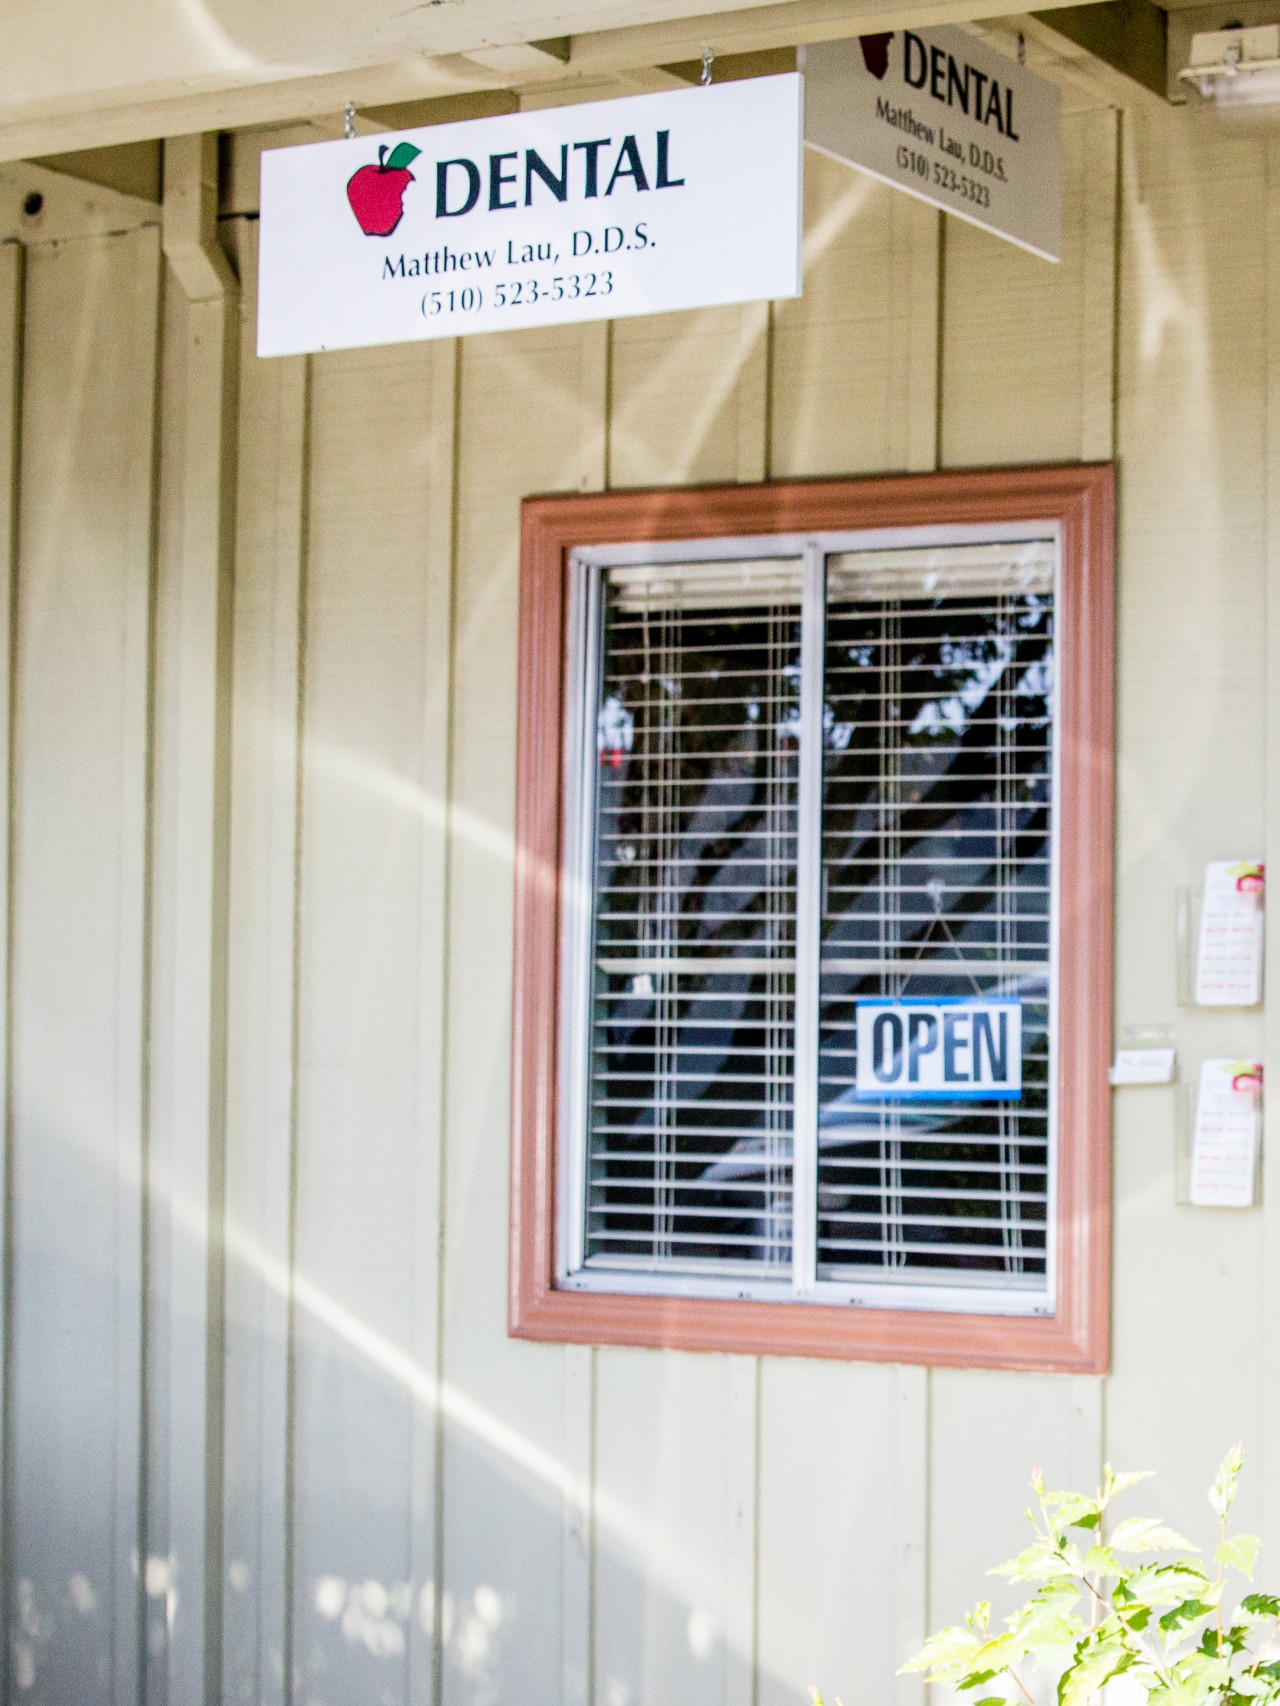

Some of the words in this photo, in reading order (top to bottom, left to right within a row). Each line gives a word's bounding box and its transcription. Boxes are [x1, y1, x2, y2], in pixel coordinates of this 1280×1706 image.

[904, 29, 1019, 142] DENTAL
[435, 129, 686, 219] DENTAL
[875, 95, 935, 146] Matthew
[939, 127, 966, 164] Lau,
[969, 142, 1009, 183] D.D.S.
[896, 145, 930, 182] (510)
[933, 163, 991, 209] 523-5323
[382, 241, 497, 281] Matthew
[507, 239, 560, 266] Lau,
[572, 222, 657, 258] D.D.S.
[421, 286, 484, 319] (510)
[494, 271, 615, 309] 523-5323
[872, 1012, 1008, 1084] OPEN
